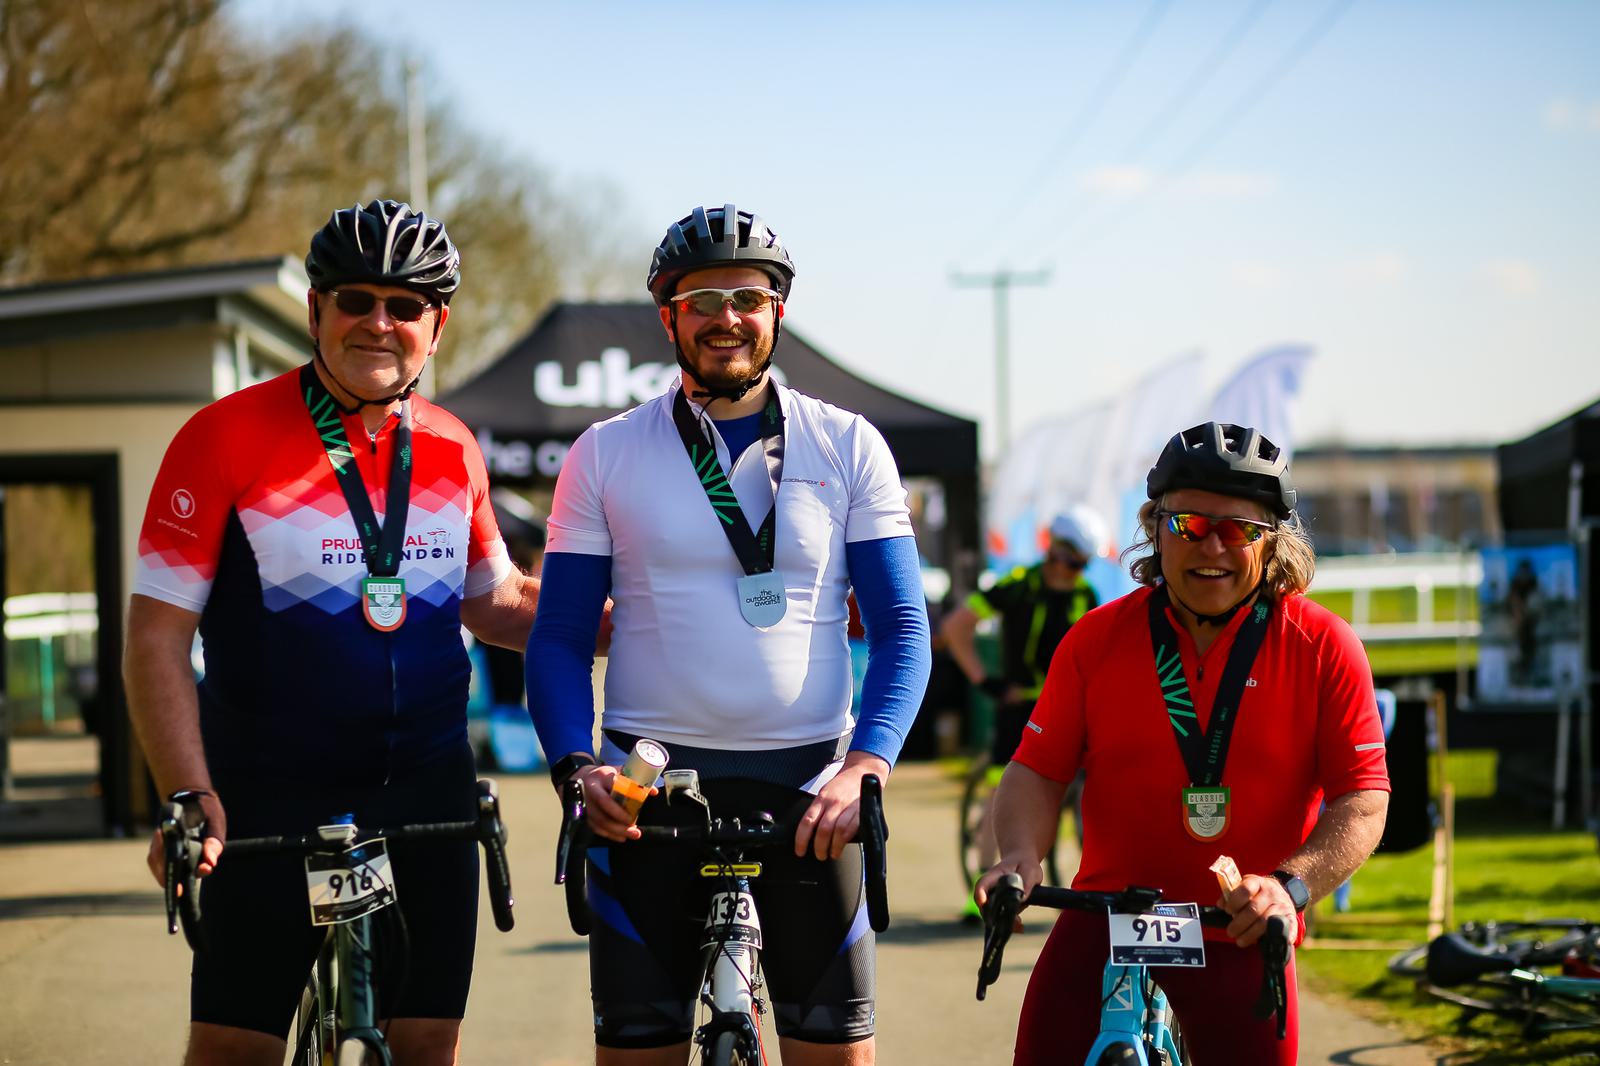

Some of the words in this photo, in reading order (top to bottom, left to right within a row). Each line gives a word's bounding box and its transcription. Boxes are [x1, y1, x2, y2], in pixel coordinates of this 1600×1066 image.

[1189, 794, 1224, 803] CLASSIC
[329, 867, 373, 898] 916
[1132, 918, 1182, 943] 915
